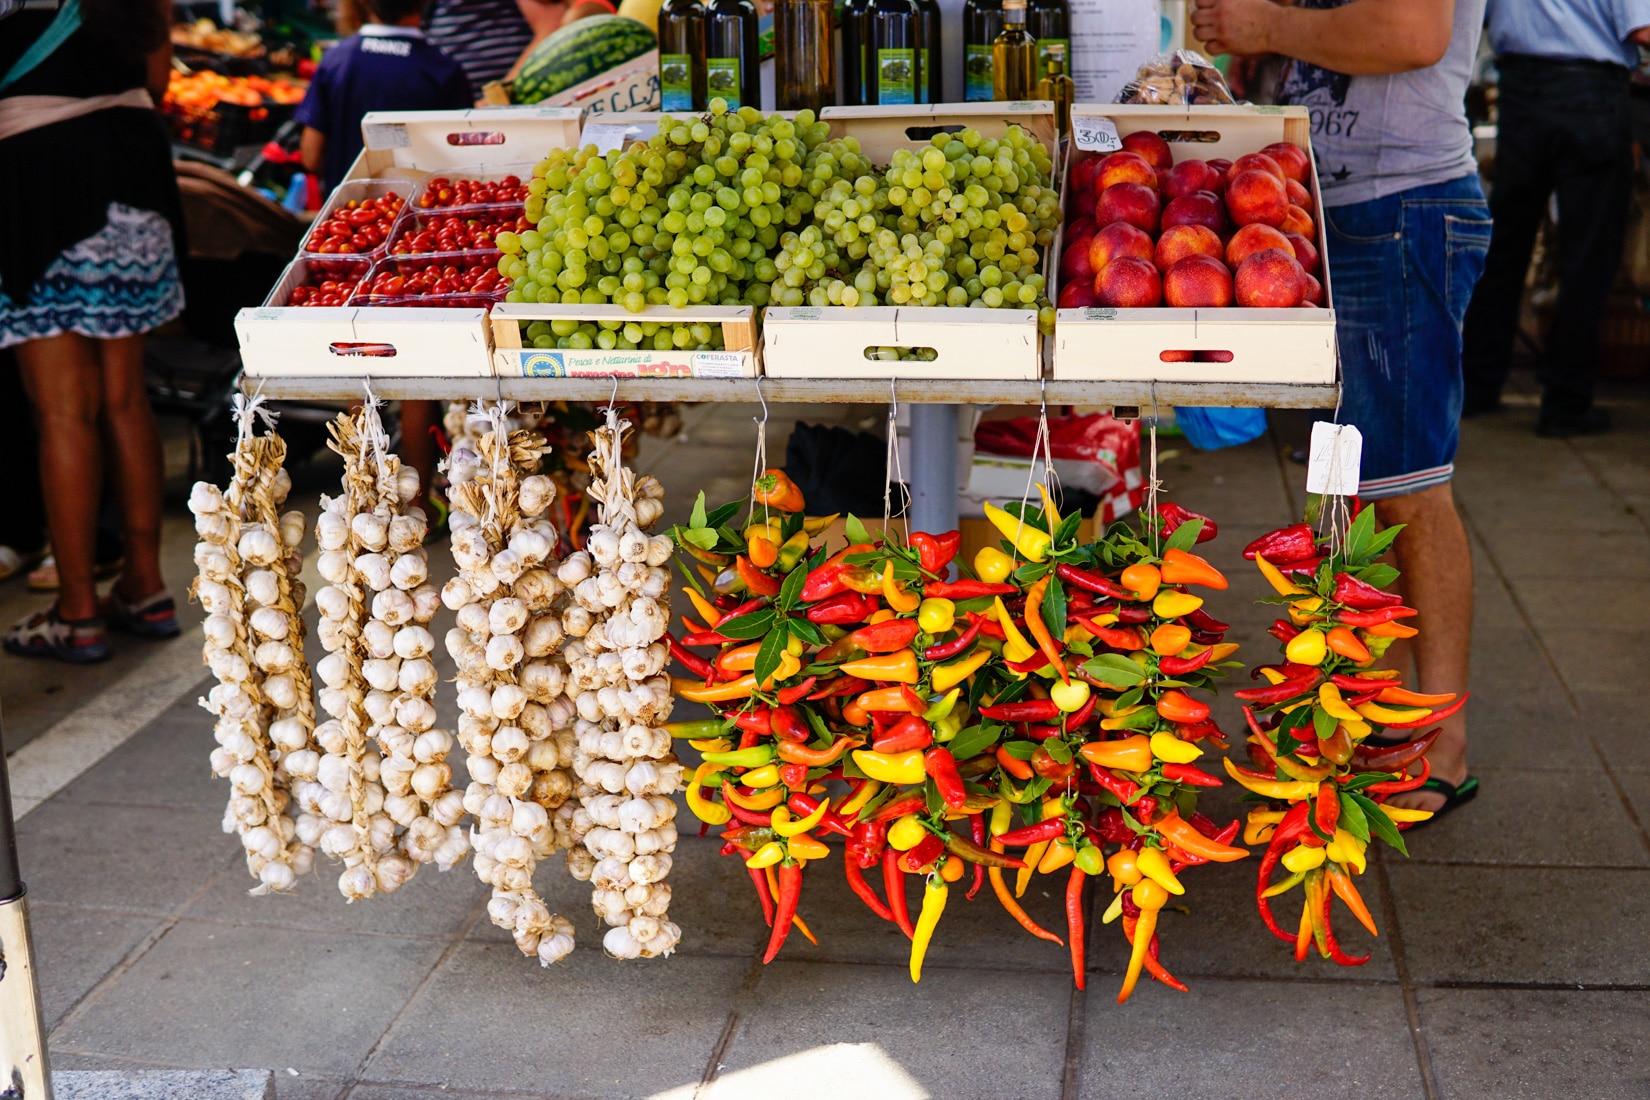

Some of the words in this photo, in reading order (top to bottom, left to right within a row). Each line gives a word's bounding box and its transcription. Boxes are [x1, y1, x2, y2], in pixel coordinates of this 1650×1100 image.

[361, 37, 412, 57] FRANCE
[568, 356, 593, 366] Pesca
[595, 357, 600, 365] e
[601, 354, 641, 366] Nettarina
[643, 353, 653, 363] di
[696, 353, 738, 361] COFERASTA
